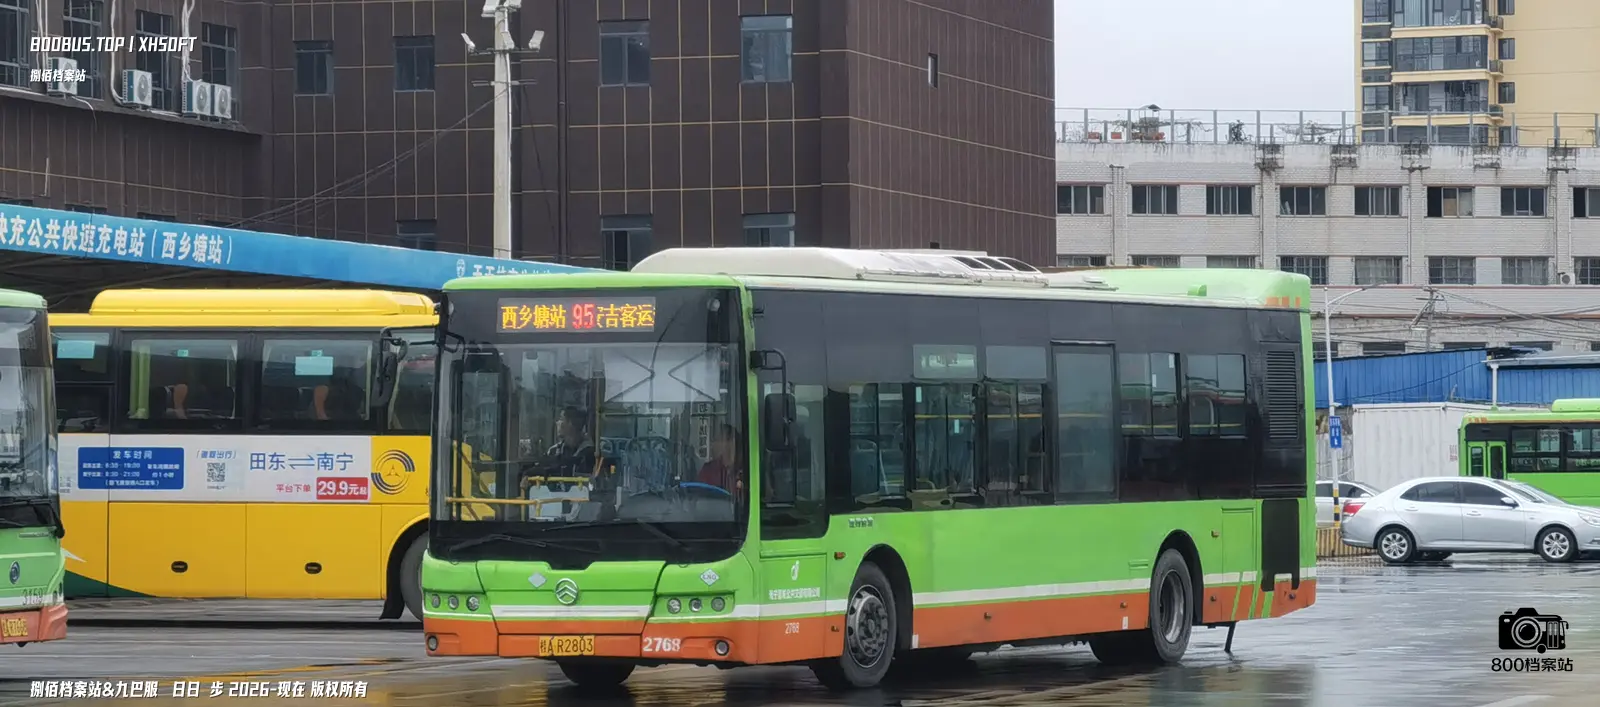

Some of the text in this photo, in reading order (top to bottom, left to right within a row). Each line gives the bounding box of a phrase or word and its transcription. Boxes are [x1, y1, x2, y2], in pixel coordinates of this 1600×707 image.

[501, 304, 566, 329] 西乡塘站
[572, 303, 596, 329] 95
[250, 453, 354, 471] 田东 南宁
[643, 637, 681, 652] 2768
